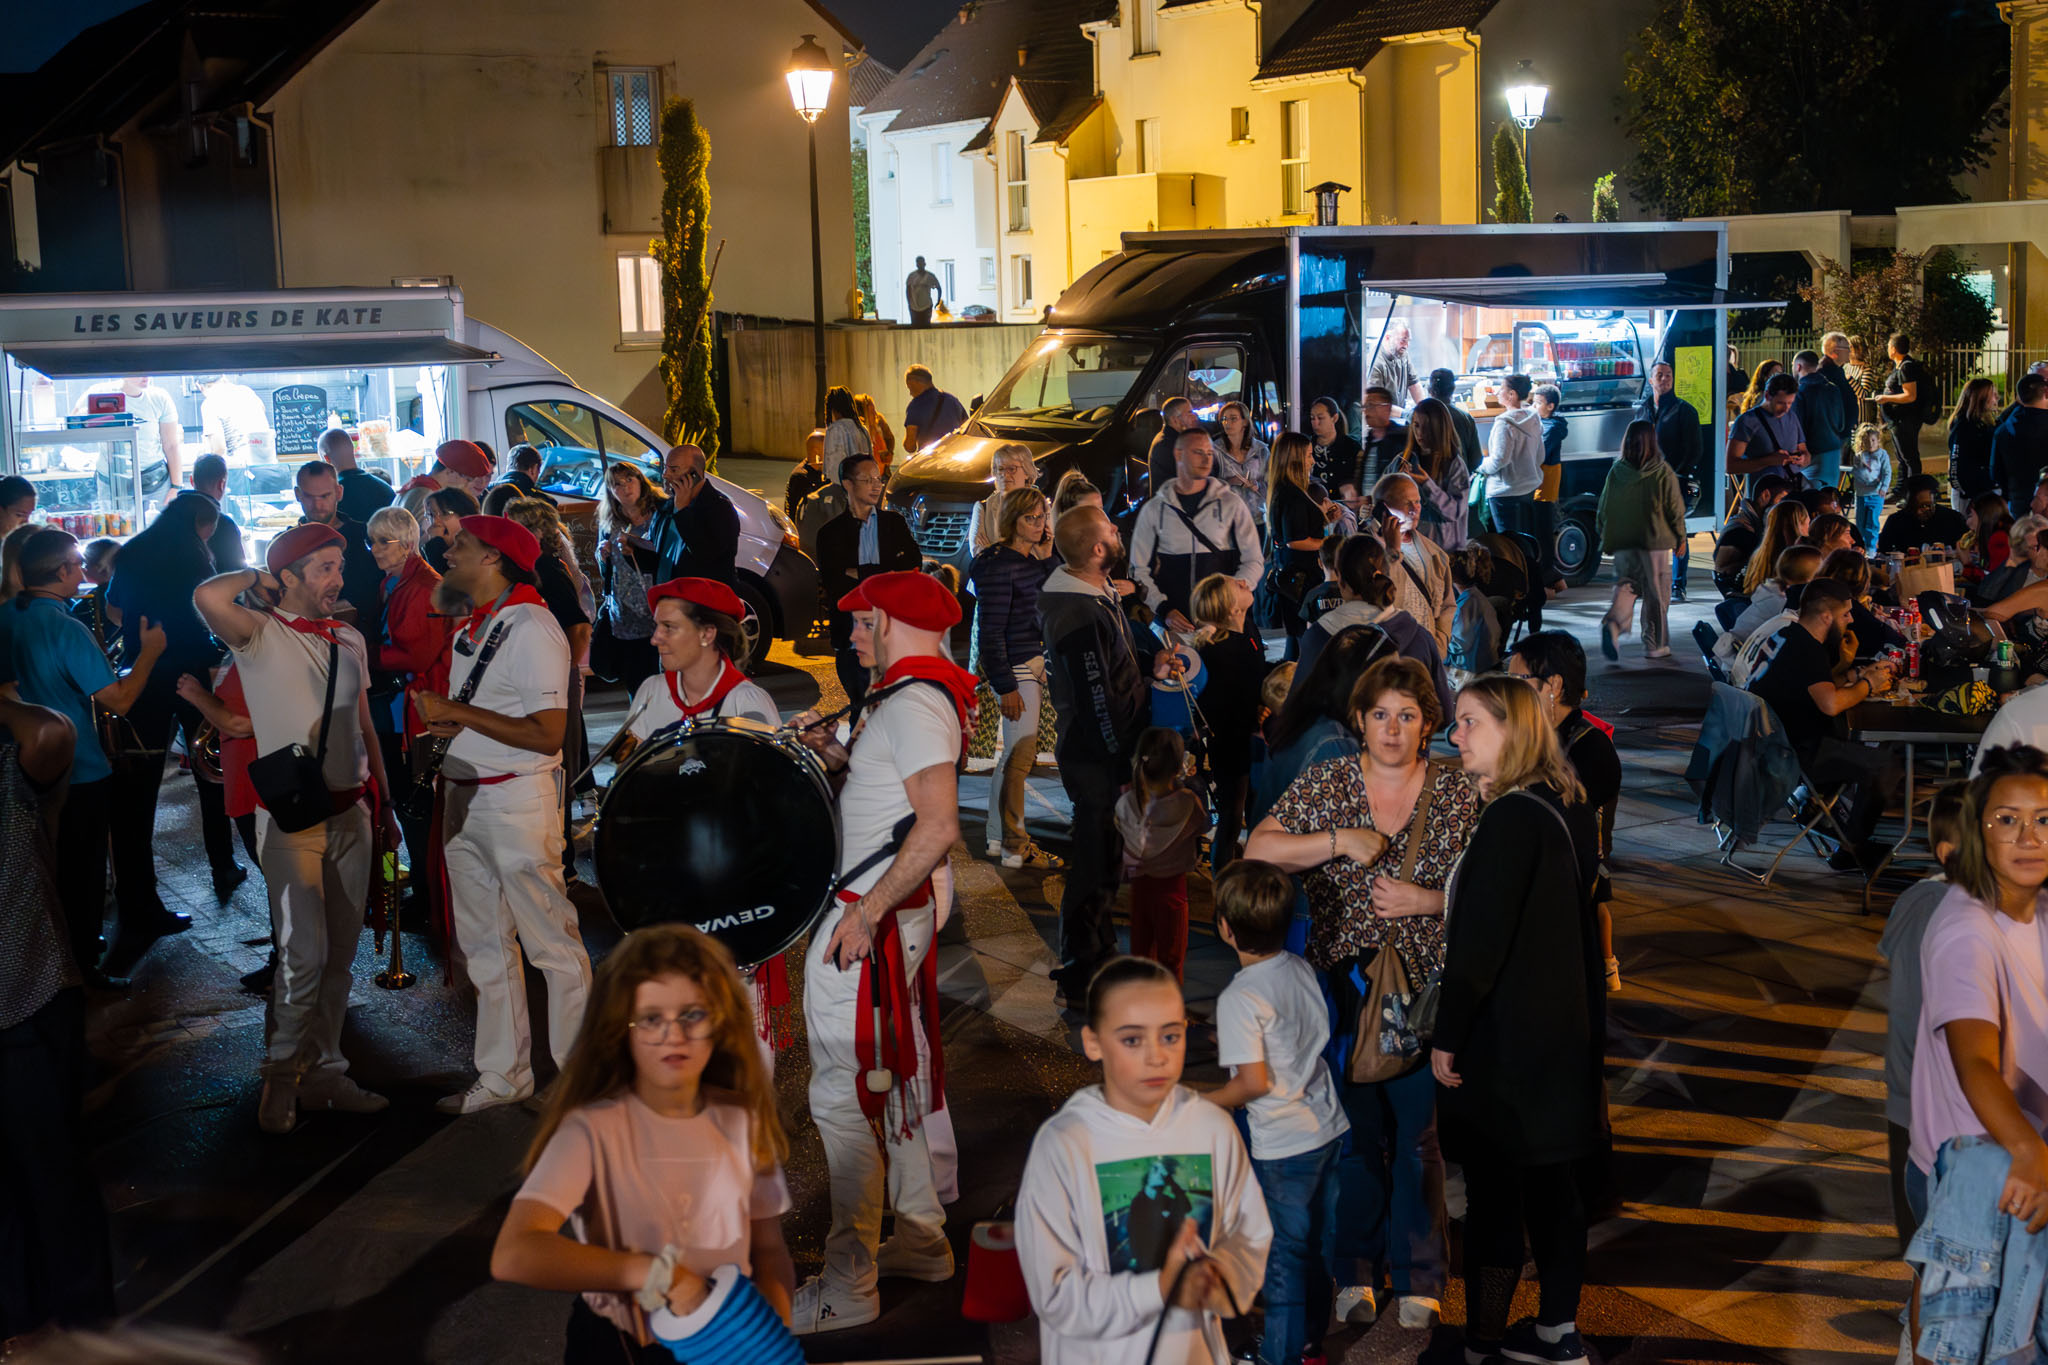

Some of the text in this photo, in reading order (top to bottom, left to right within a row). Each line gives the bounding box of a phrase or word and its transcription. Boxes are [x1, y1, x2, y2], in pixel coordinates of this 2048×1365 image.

[74, 308, 382, 333] LES SAVEURS DE KATE
[1084, 651, 1100, 682] SEA
[694, 905, 775, 934] GEWA
